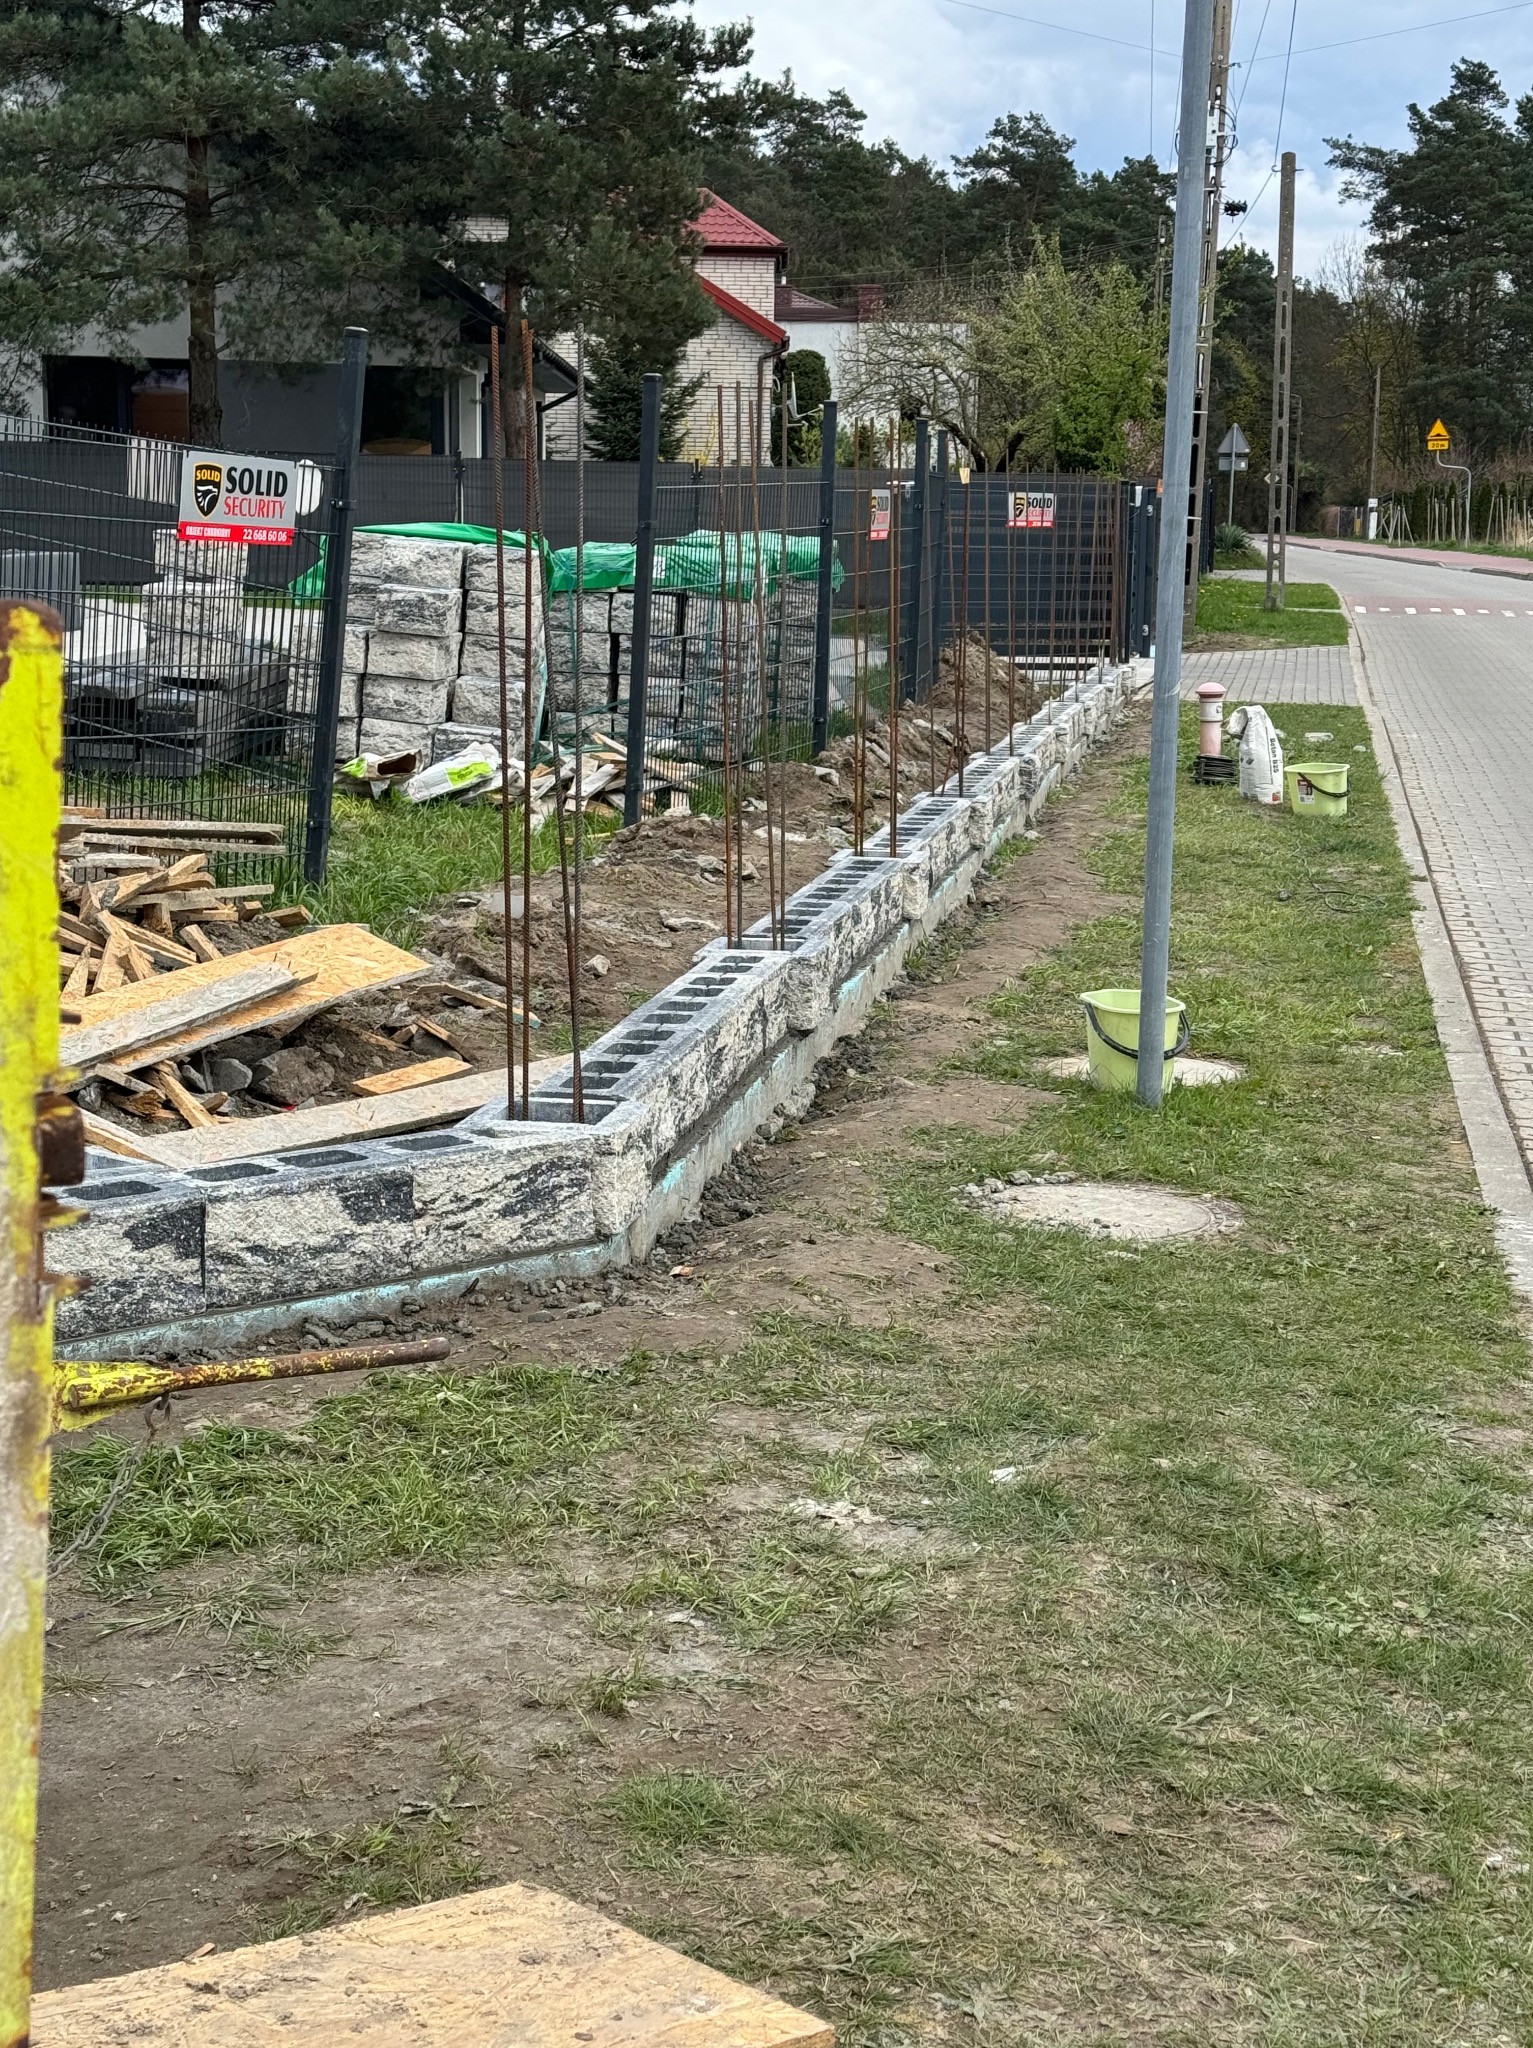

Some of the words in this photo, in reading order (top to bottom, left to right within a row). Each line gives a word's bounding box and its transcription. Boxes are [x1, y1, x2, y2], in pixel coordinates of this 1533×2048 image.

[195, 469, 221, 482] SOLID
[225, 466, 288, 497] SOLID
[223, 496, 286, 519] SECURITY
[1027, 497, 1053, 509] SOLID
[242, 528, 252, 540] 22
[252, 529, 267, 541] 668
[267, 530, 277, 542] 60
[277, 531, 288, 542] 06
